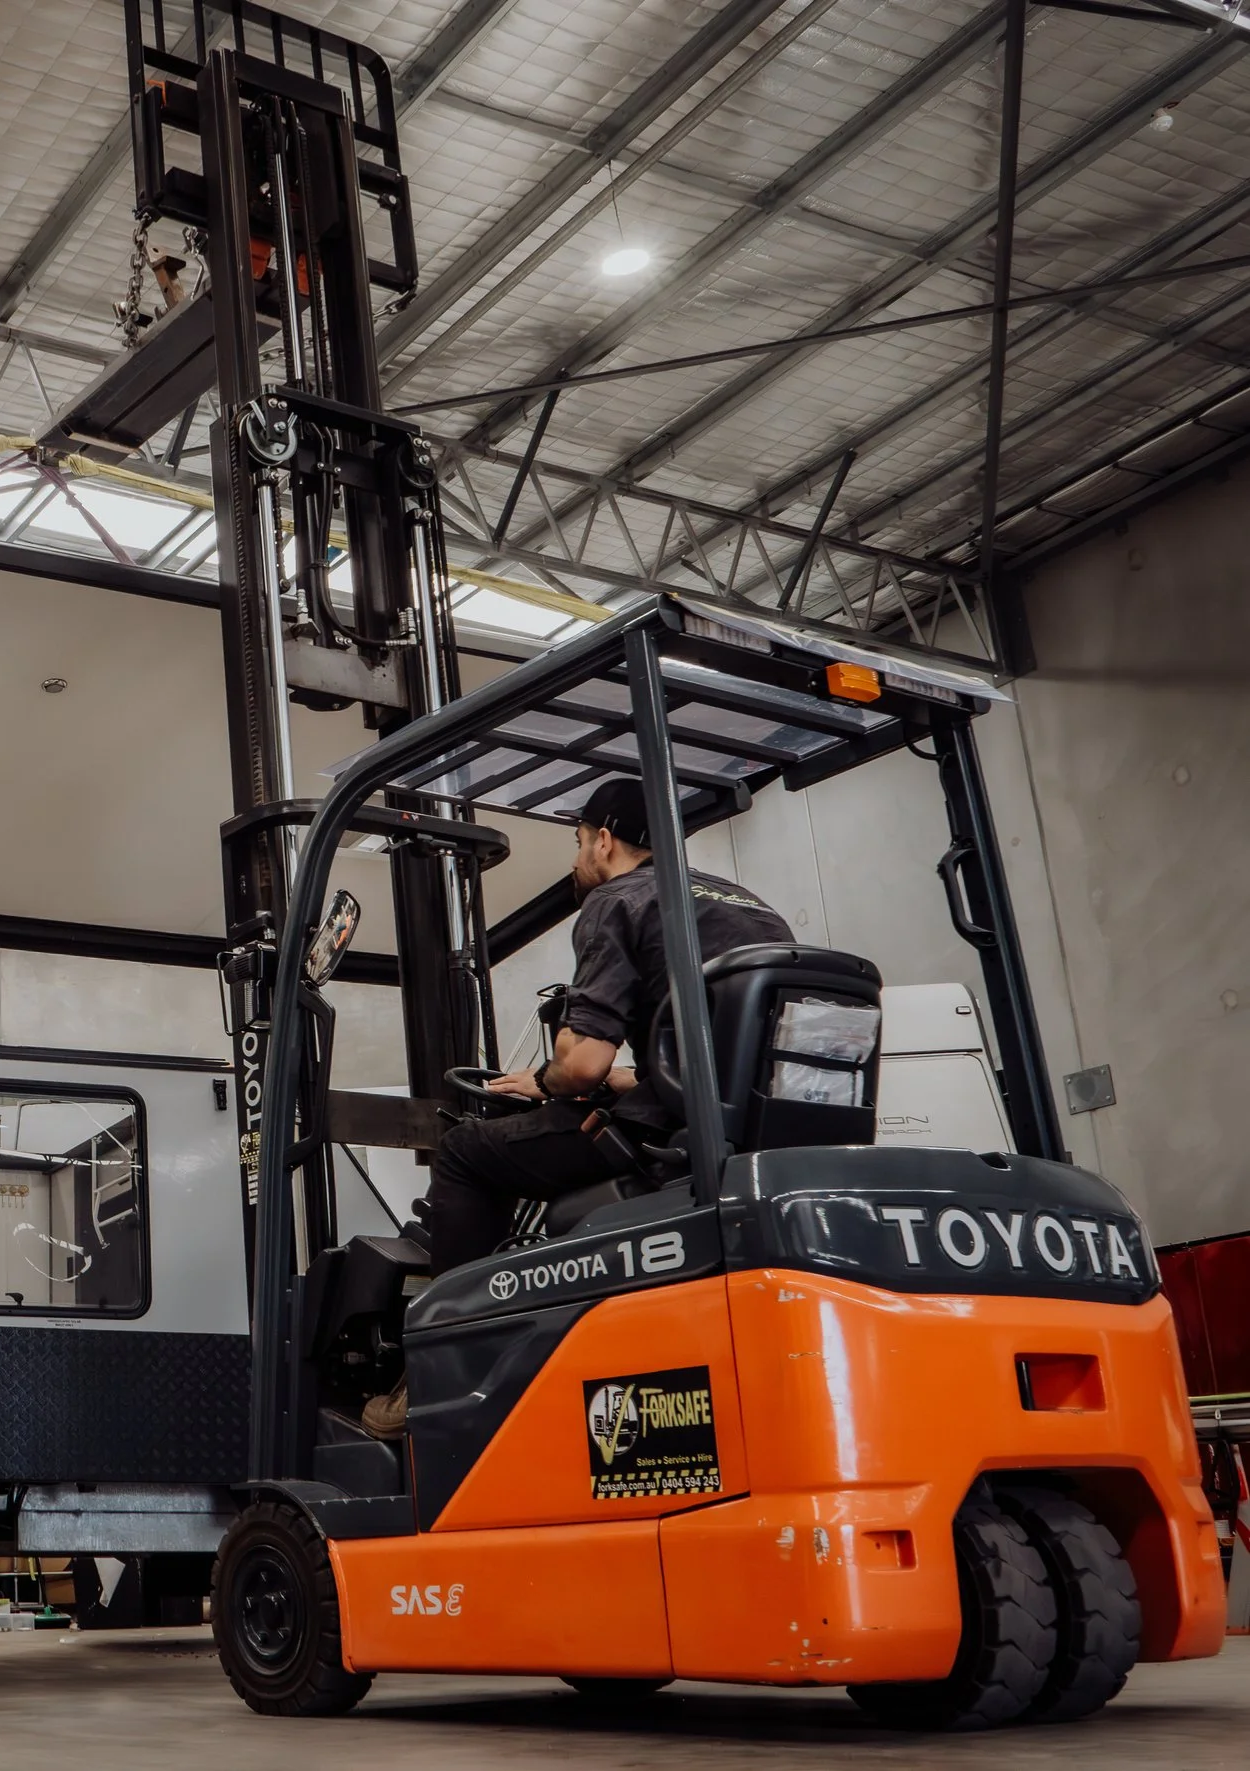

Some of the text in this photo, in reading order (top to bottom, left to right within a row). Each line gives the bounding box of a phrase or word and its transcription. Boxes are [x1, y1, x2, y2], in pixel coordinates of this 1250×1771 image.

[241, 1032, 262, 1131] TOYO
[878, 1115, 929, 1125] ION
[520, 1231, 686, 1291] TOYOTA 18
[881, 1208, 1140, 1279] TOYOTA
[638, 1387, 712, 1438] FORKSAFE
[597, 1481, 656, 1493] forksafe.com.au
[661, 1477, 683, 1489] 0404
[684, 1476, 701, 1488] 594
[702, 1475, 720, 1487] 243
[636, 1453, 713, 1467] Sales Service Hire
